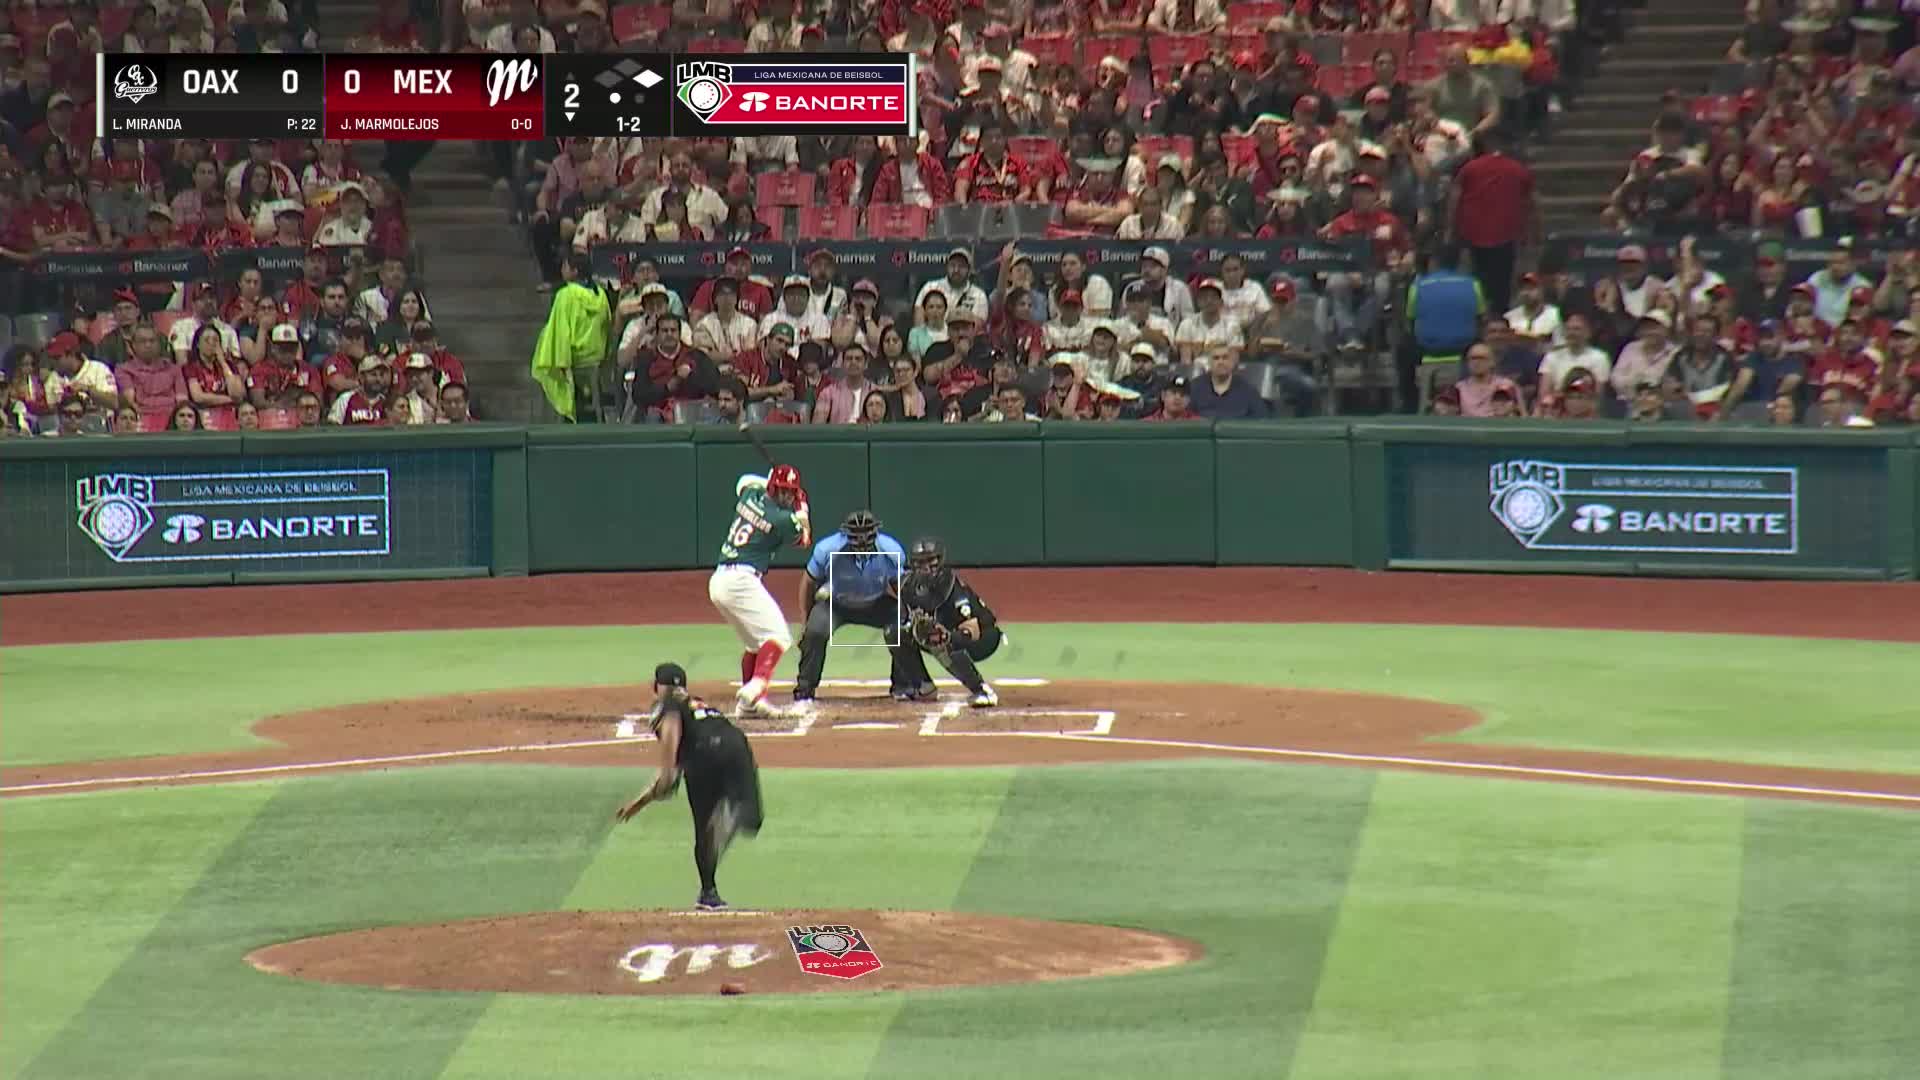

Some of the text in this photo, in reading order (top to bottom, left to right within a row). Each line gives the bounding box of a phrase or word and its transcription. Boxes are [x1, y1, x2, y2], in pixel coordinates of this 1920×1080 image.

[76, 473, 156, 508] LMB
[1489, 461, 1566, 494] LMB
[211, 514, 379, 541] BANORTE
[1619, 510, 1787, 535] BANORTE
